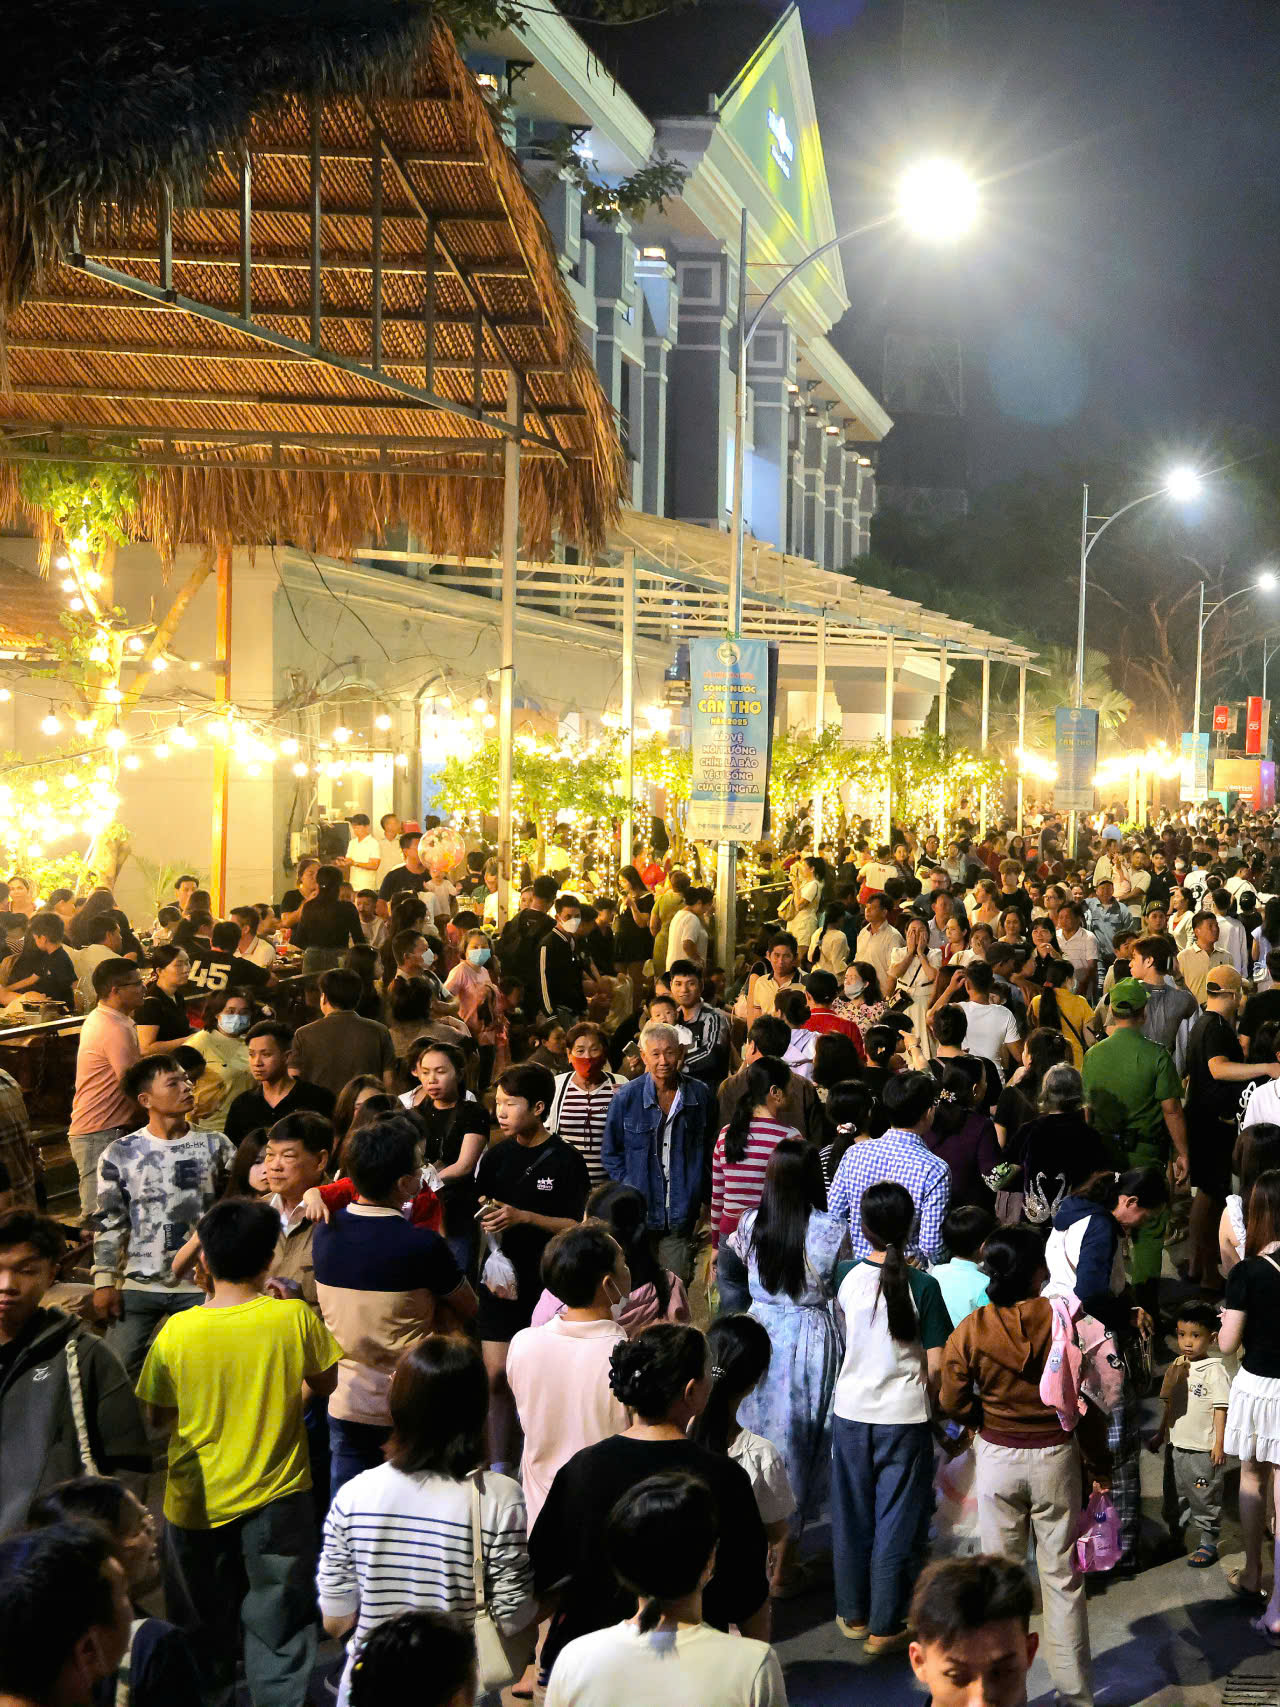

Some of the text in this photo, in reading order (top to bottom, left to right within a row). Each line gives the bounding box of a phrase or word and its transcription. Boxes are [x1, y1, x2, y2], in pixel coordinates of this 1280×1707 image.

[703, 682, 756, 693] SÔNG NƯỚC
[698, 693, 762, 715] CẦN THƠ
[727, 717, 748, 726] 2025
[730, 732, 743, 744] VỆ
[725, 757, 737, 767] LÀ
[738, 757, 759, 768] BẢO
[703, 769, 715, 781] VỆ
[725, 769, 753, 781] SỐNG
[697, 781, 715, 792] CỦA
[715, 782, 746, 793] CHÚNG
[188, 960, 231, 990] 45
